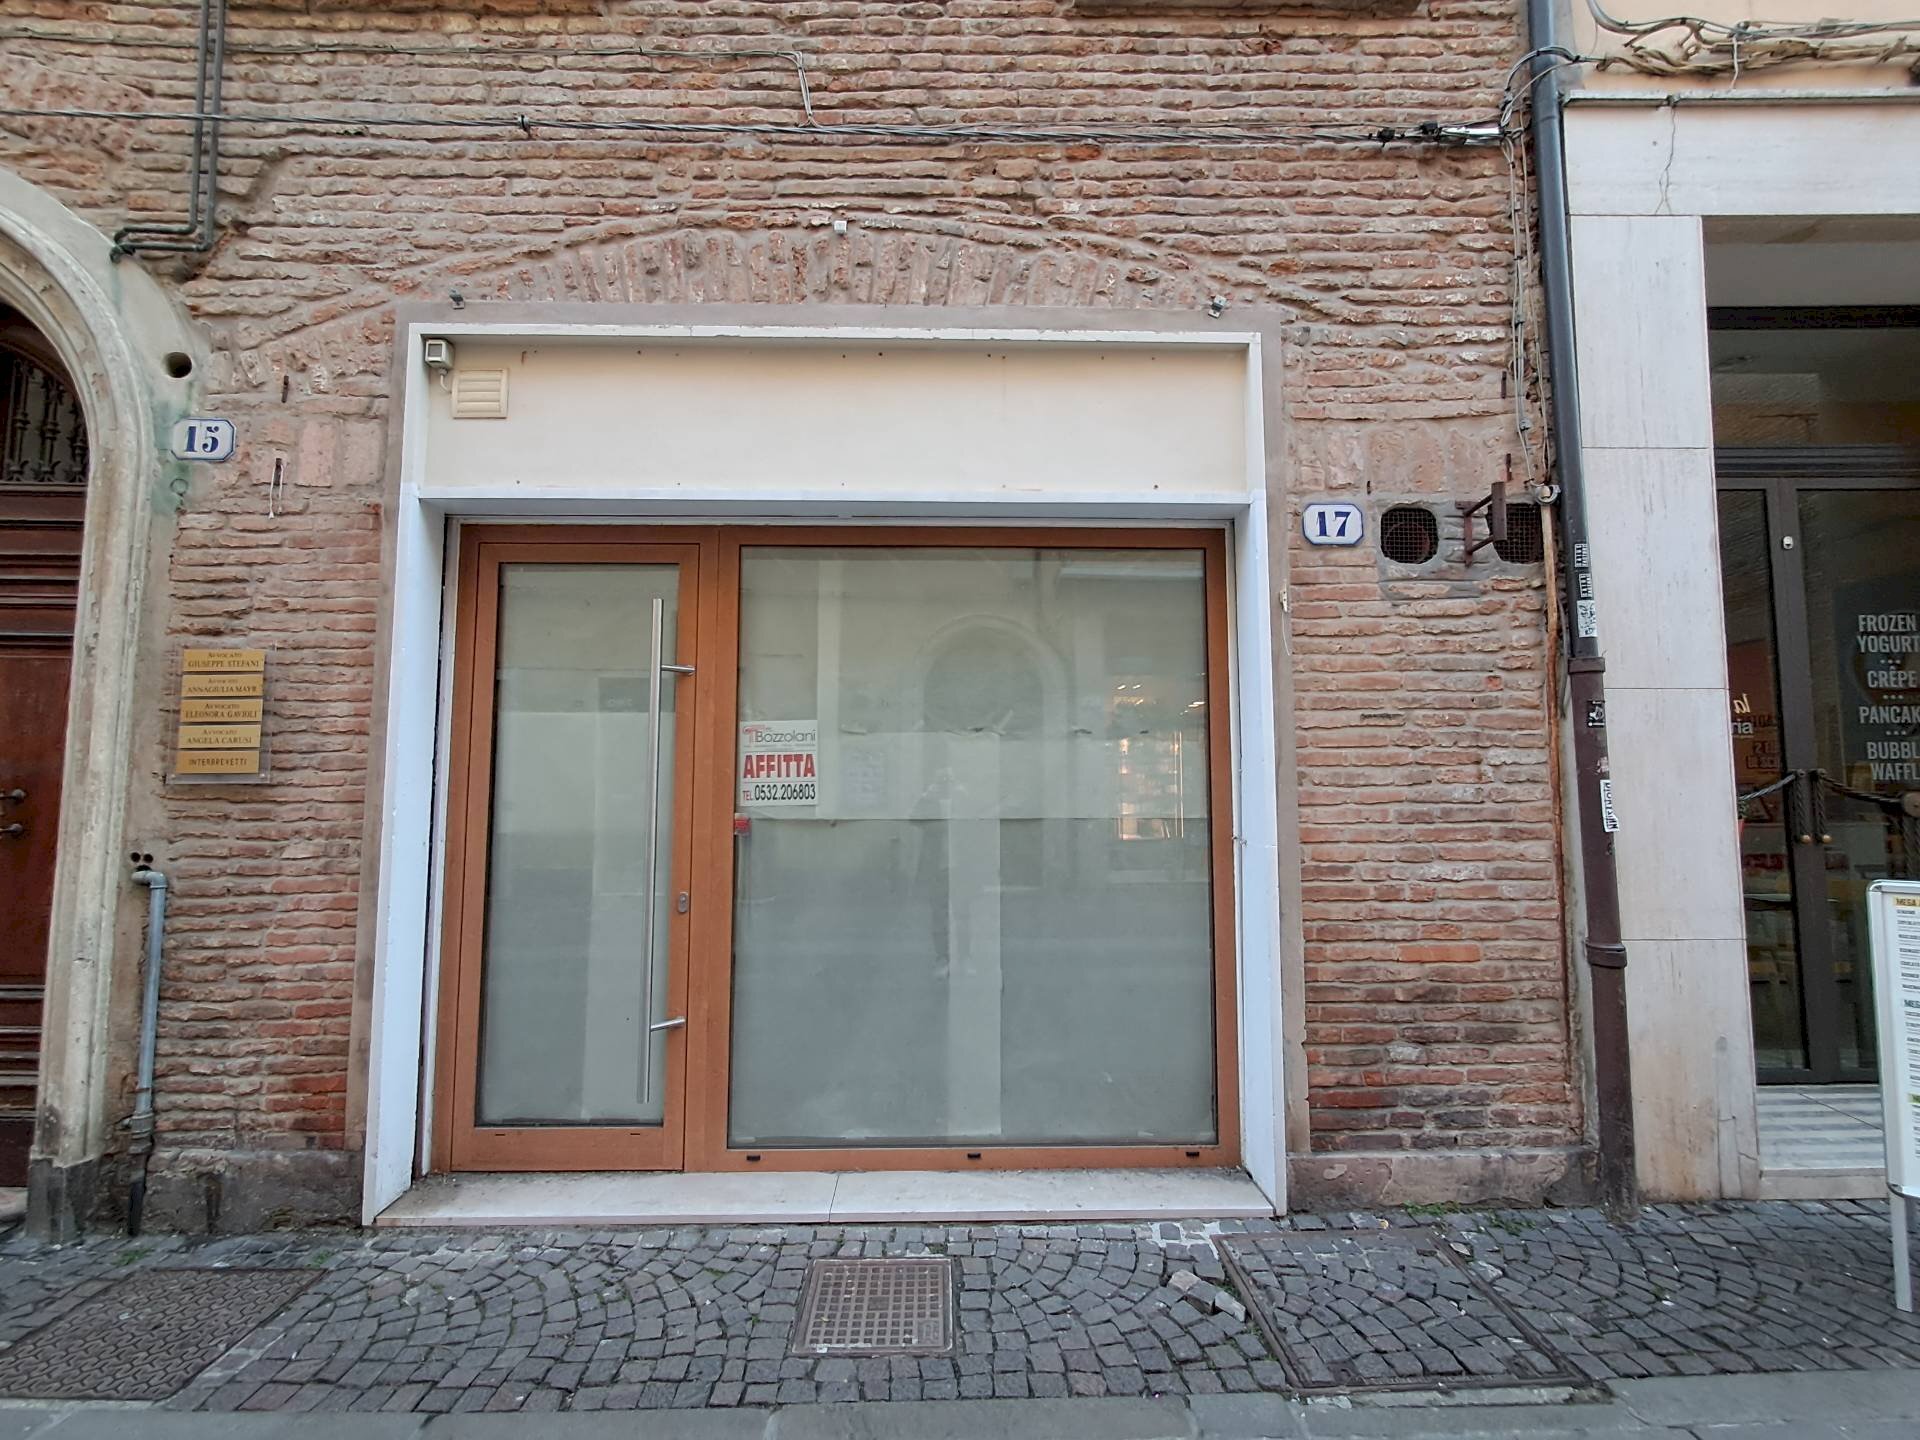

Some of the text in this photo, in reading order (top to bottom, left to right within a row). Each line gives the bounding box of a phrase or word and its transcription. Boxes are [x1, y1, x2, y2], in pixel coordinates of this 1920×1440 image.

[184, 426, 219, 453] 15
[1316, 511, 1351, 537] 17
[1858, 614, 1917, 632] FROZEN
[1857, 635, 1920, 653] YOGURT
[1867, 665, 1918, 688] CRÊPE
[221, 736, 252, 744] CARUSI
[755, 729, 816, 742] Bozzolani
[1866, 741, 1920, 760] BUBBL
[189, 758, 247, 766] INTERBREVETTI
[743, 754, 815, 778] AFFITTA
[1870, 762, 1920, 780] WAFFL
[755, 783, 815, 800] 0532.206803
